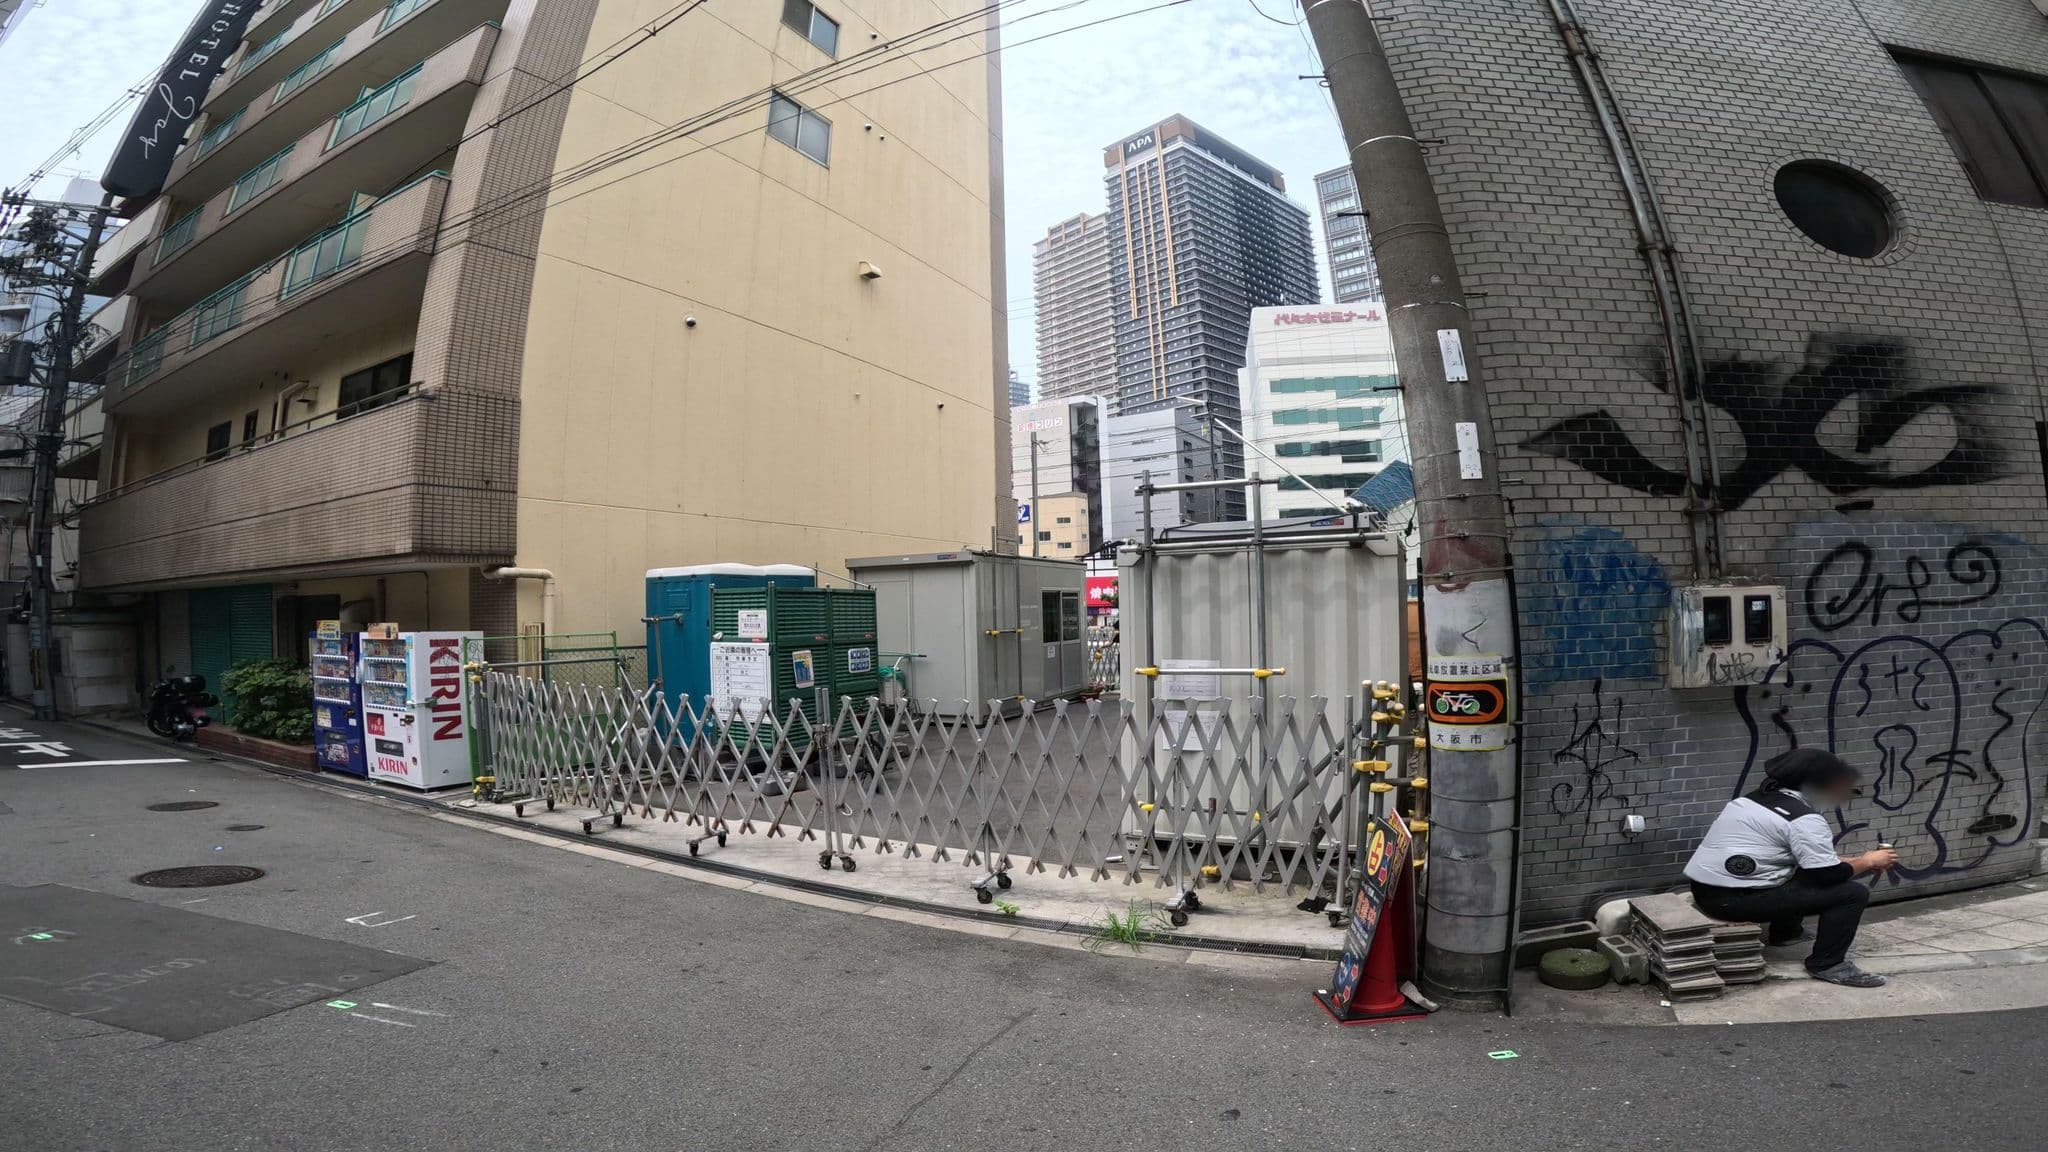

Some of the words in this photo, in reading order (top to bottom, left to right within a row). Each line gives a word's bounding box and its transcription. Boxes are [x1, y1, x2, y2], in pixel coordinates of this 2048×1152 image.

[179, 3, 242, 81] HOTEL
[1128, 135, 1153, 153] APA
[429, 638, 463, 741] KIRIN
[1436, 733, 1483, 745] 大阪市
[377, 756, 408, 775] KIRIN
